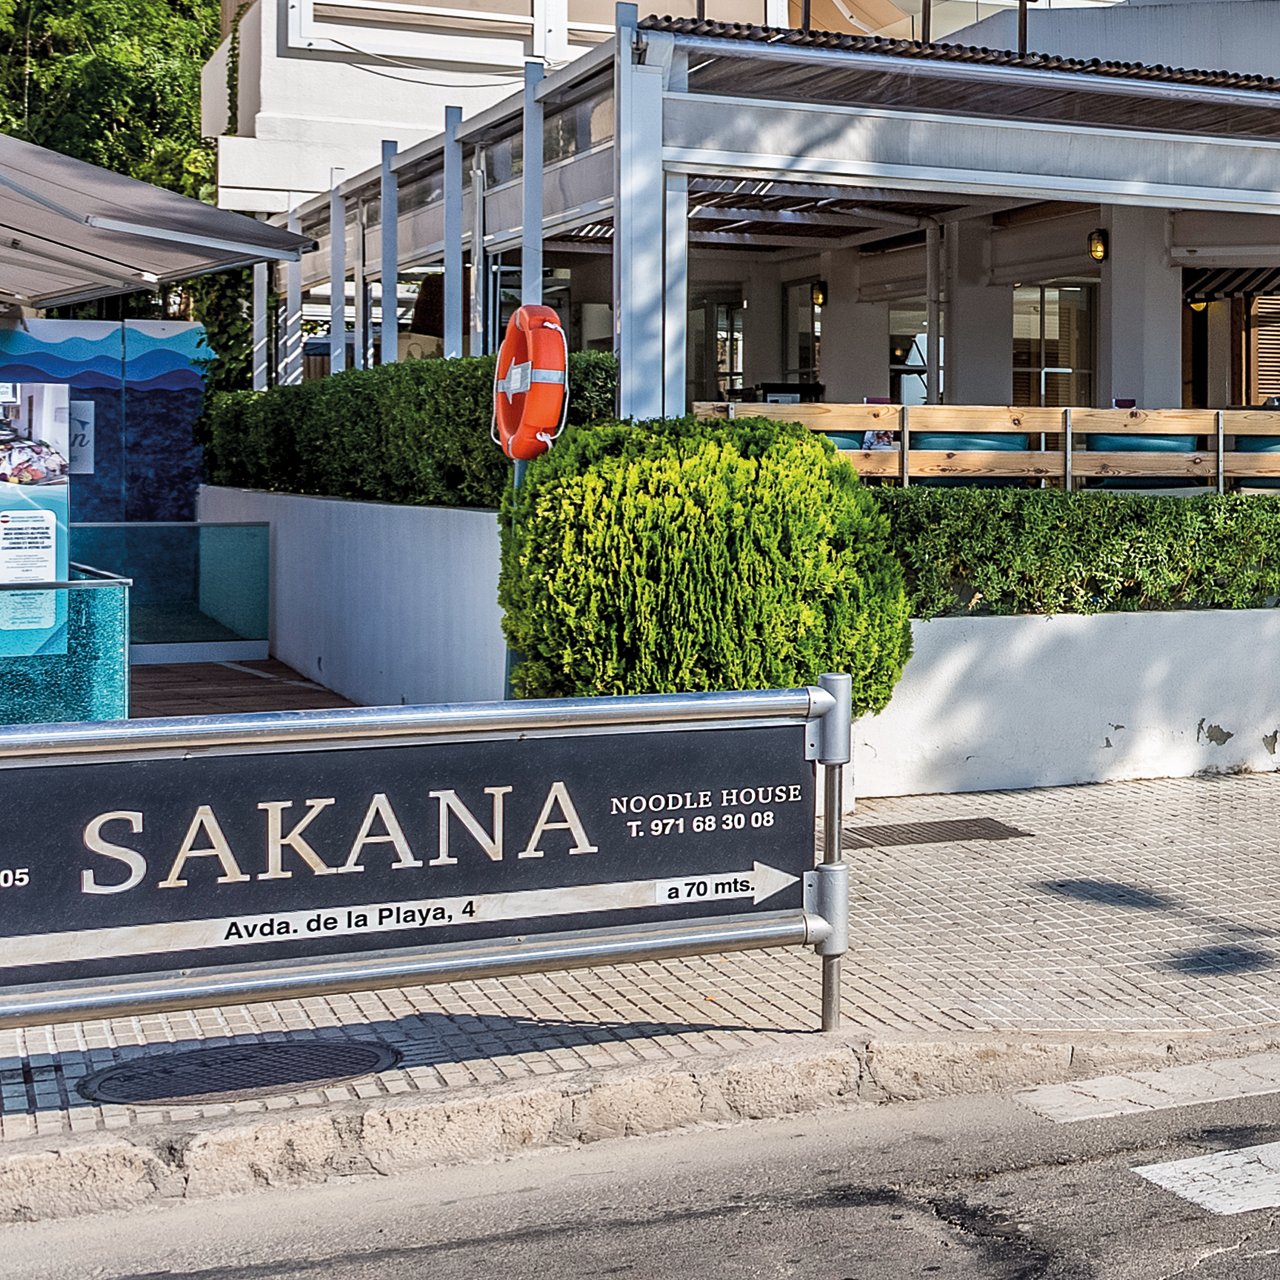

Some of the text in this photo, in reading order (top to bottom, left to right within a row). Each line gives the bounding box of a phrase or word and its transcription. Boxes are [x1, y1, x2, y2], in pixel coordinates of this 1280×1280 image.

[610, 785, 802, 815] NOODLE HOUSE
[81, 781, 598, 895] SAKANA
[627, 811, 775, 838] T. 971 68 30 08
[667, 878, 755, 899] a 70 mts.
[224, 900, 476, 940] Avda. de la Playa, 4
